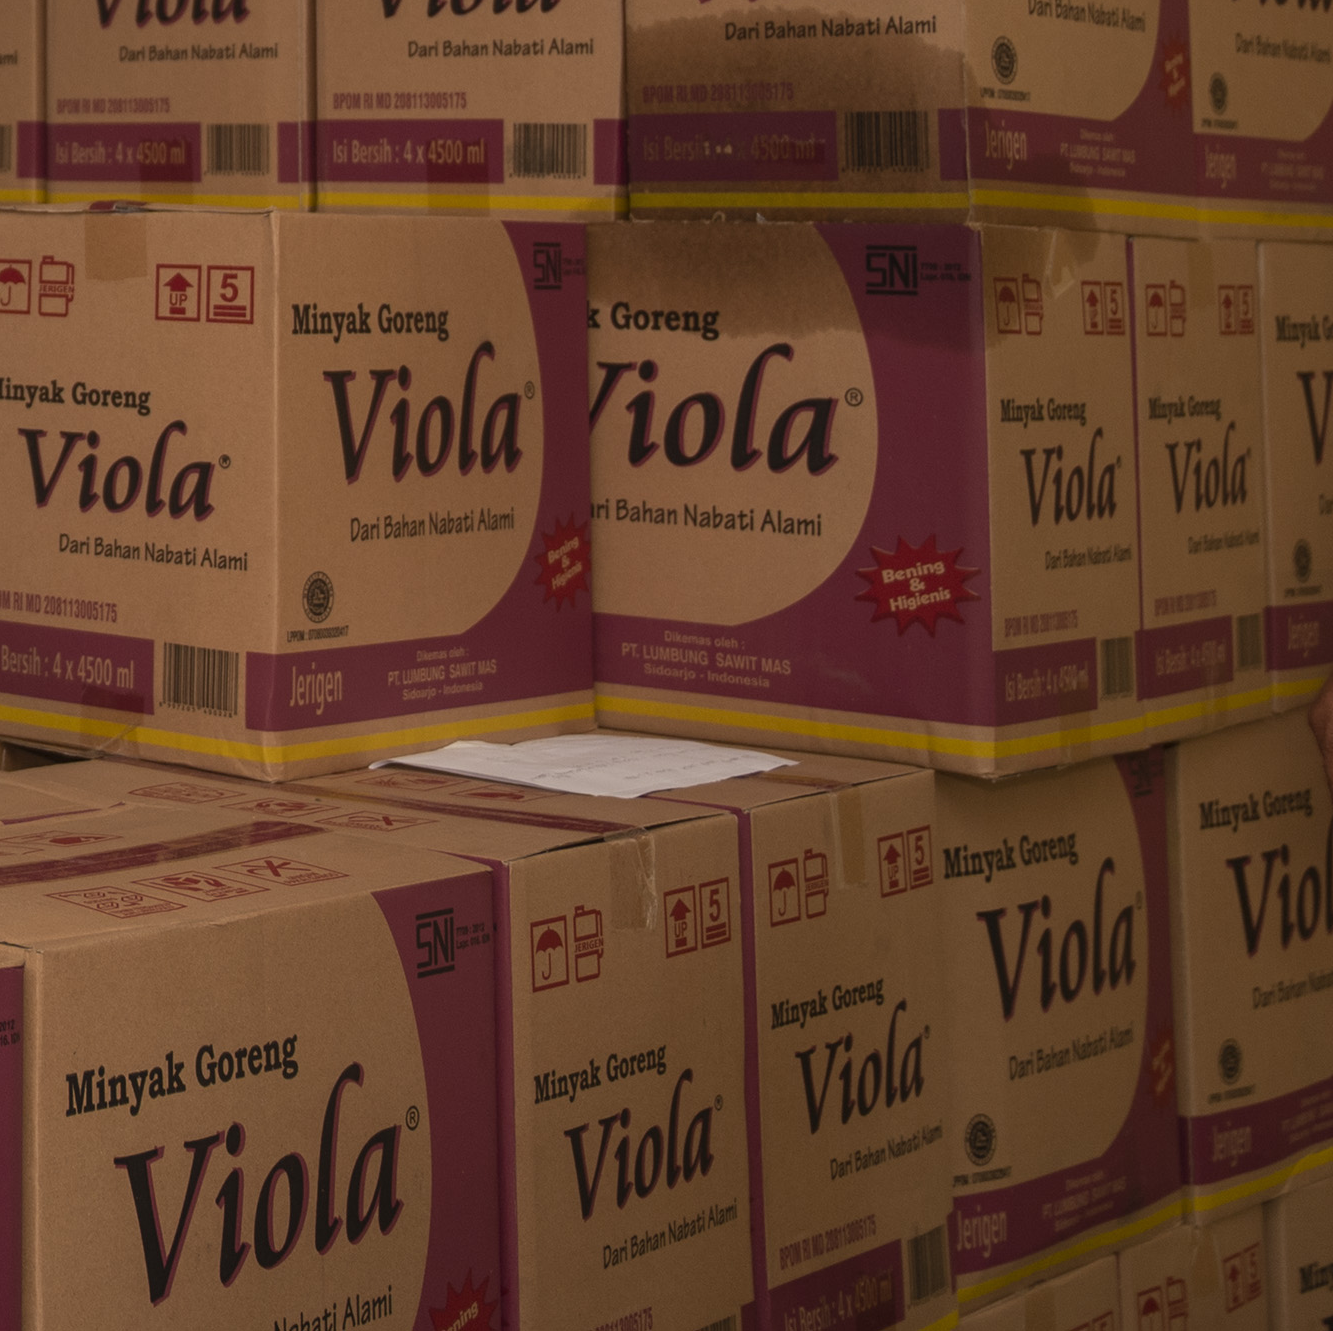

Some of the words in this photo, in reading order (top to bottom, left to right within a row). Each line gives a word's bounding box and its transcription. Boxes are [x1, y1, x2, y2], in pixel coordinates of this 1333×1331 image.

[220, 273, 239, 304] 5
[866, 250, 919, 291] SNI
[168, 292, 188, 307] UP
[291, 304, 372, 345] Minyak
[377, 306, 450, 342] Goreng
[610, 302, 721, 341] Goreng
[71, 382, 151, 416] Goreng
[322, 340, 525, 485] Viola
[17, 419, 216, 523] Viola
[1020, 428, 1118, 528] Viola
[1166, 422, 1247, 515] Viola
[880, 557, 947, 587] Bening
[888, 585, 953, 614] Higienis
[0, 645, 42, 676] Bersih
[52, 653, 63, 680] 4
[64, 658, 75, 680] x
[77, 656, 114, 687] 4500
[115, 661, 135, 690] ml
[289, 667, 343, 713] Jerigen
[976, 856, 1137, 1023] Viola
[64, 1062, 186, 1120] Minyak
[194, 1033, 300, 1091] Goreng
[532, 1066, 603, 1107] Minyak
[604, 1044, 668, 1083] Goreng
[795, 997, 927, 1137] Viola
[564, 1068, 715, 1223] Viola
[113, 1062, 405, 1309] Viola
